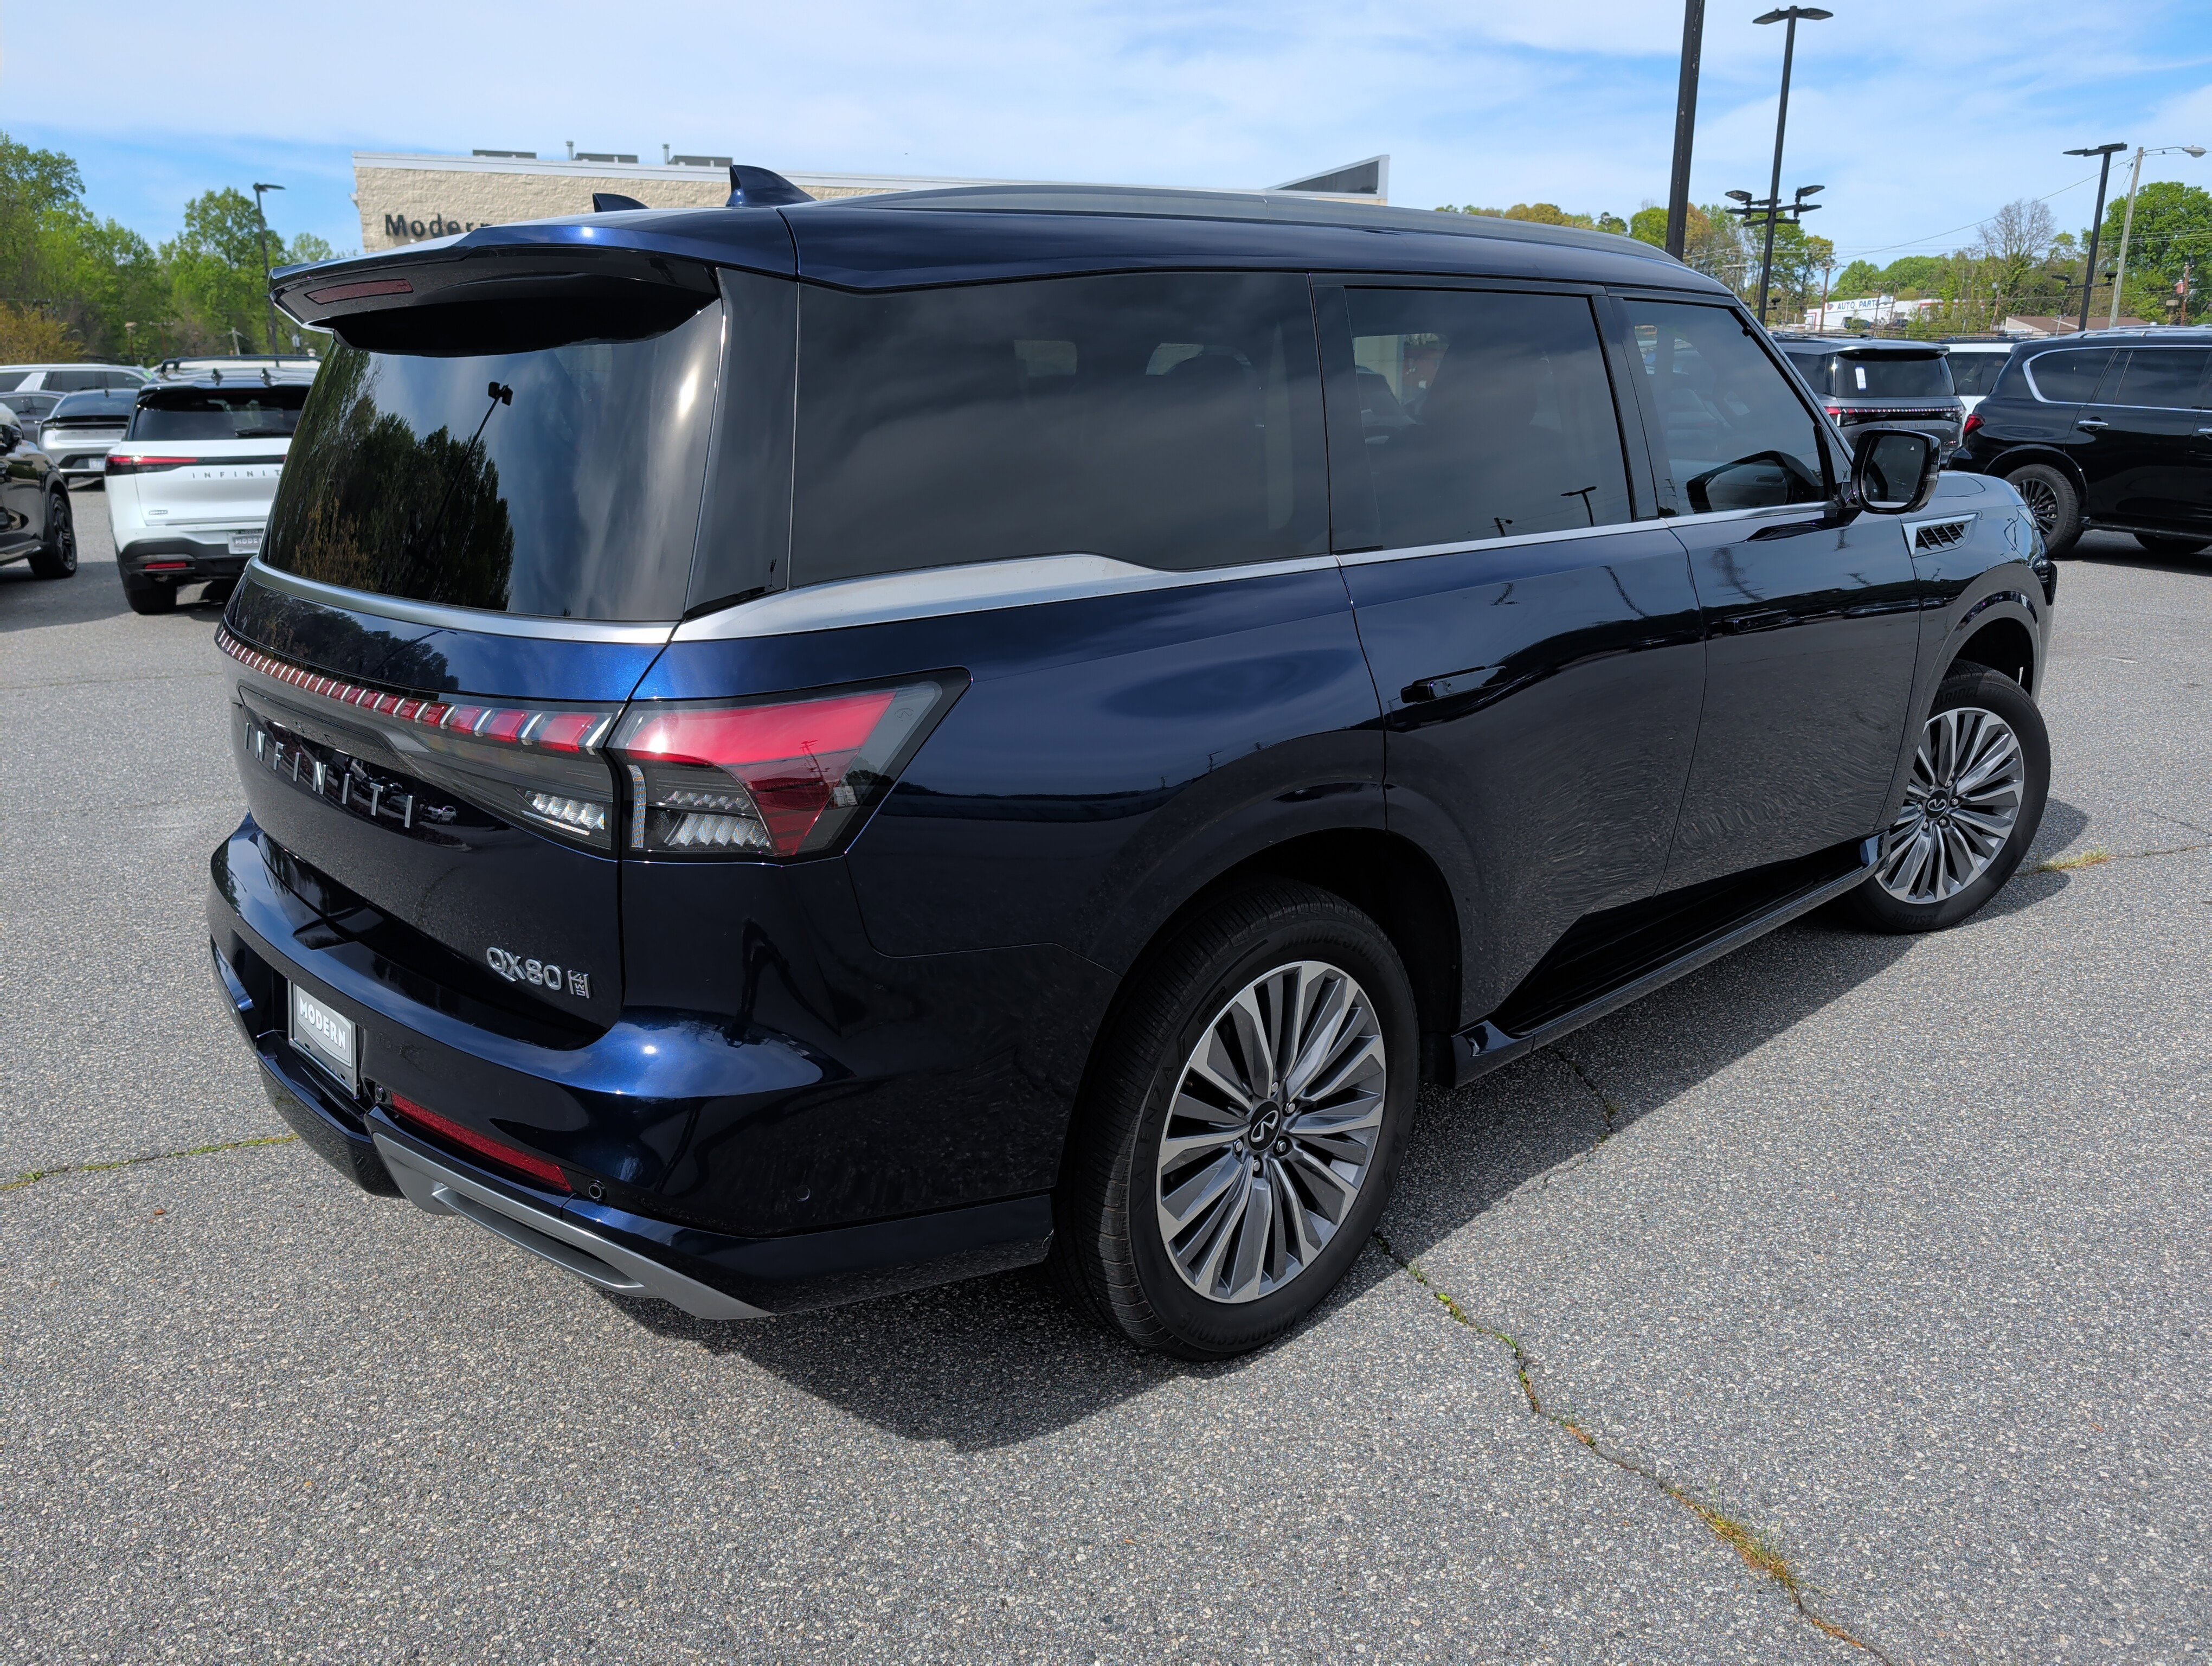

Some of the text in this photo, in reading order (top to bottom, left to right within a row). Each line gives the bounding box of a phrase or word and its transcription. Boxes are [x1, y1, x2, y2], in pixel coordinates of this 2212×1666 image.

[1837, 299, 1880, 310] AUTO PART
[245, 722, 414, 828] INFINITI
[487, 947, 563, 990] QX80
[1277, 925, 1389, 973] BRIDGESTONE
[300, 996, 346, 1050] MODERN
[1134, 1067, 1175, 1183] ALENZA
